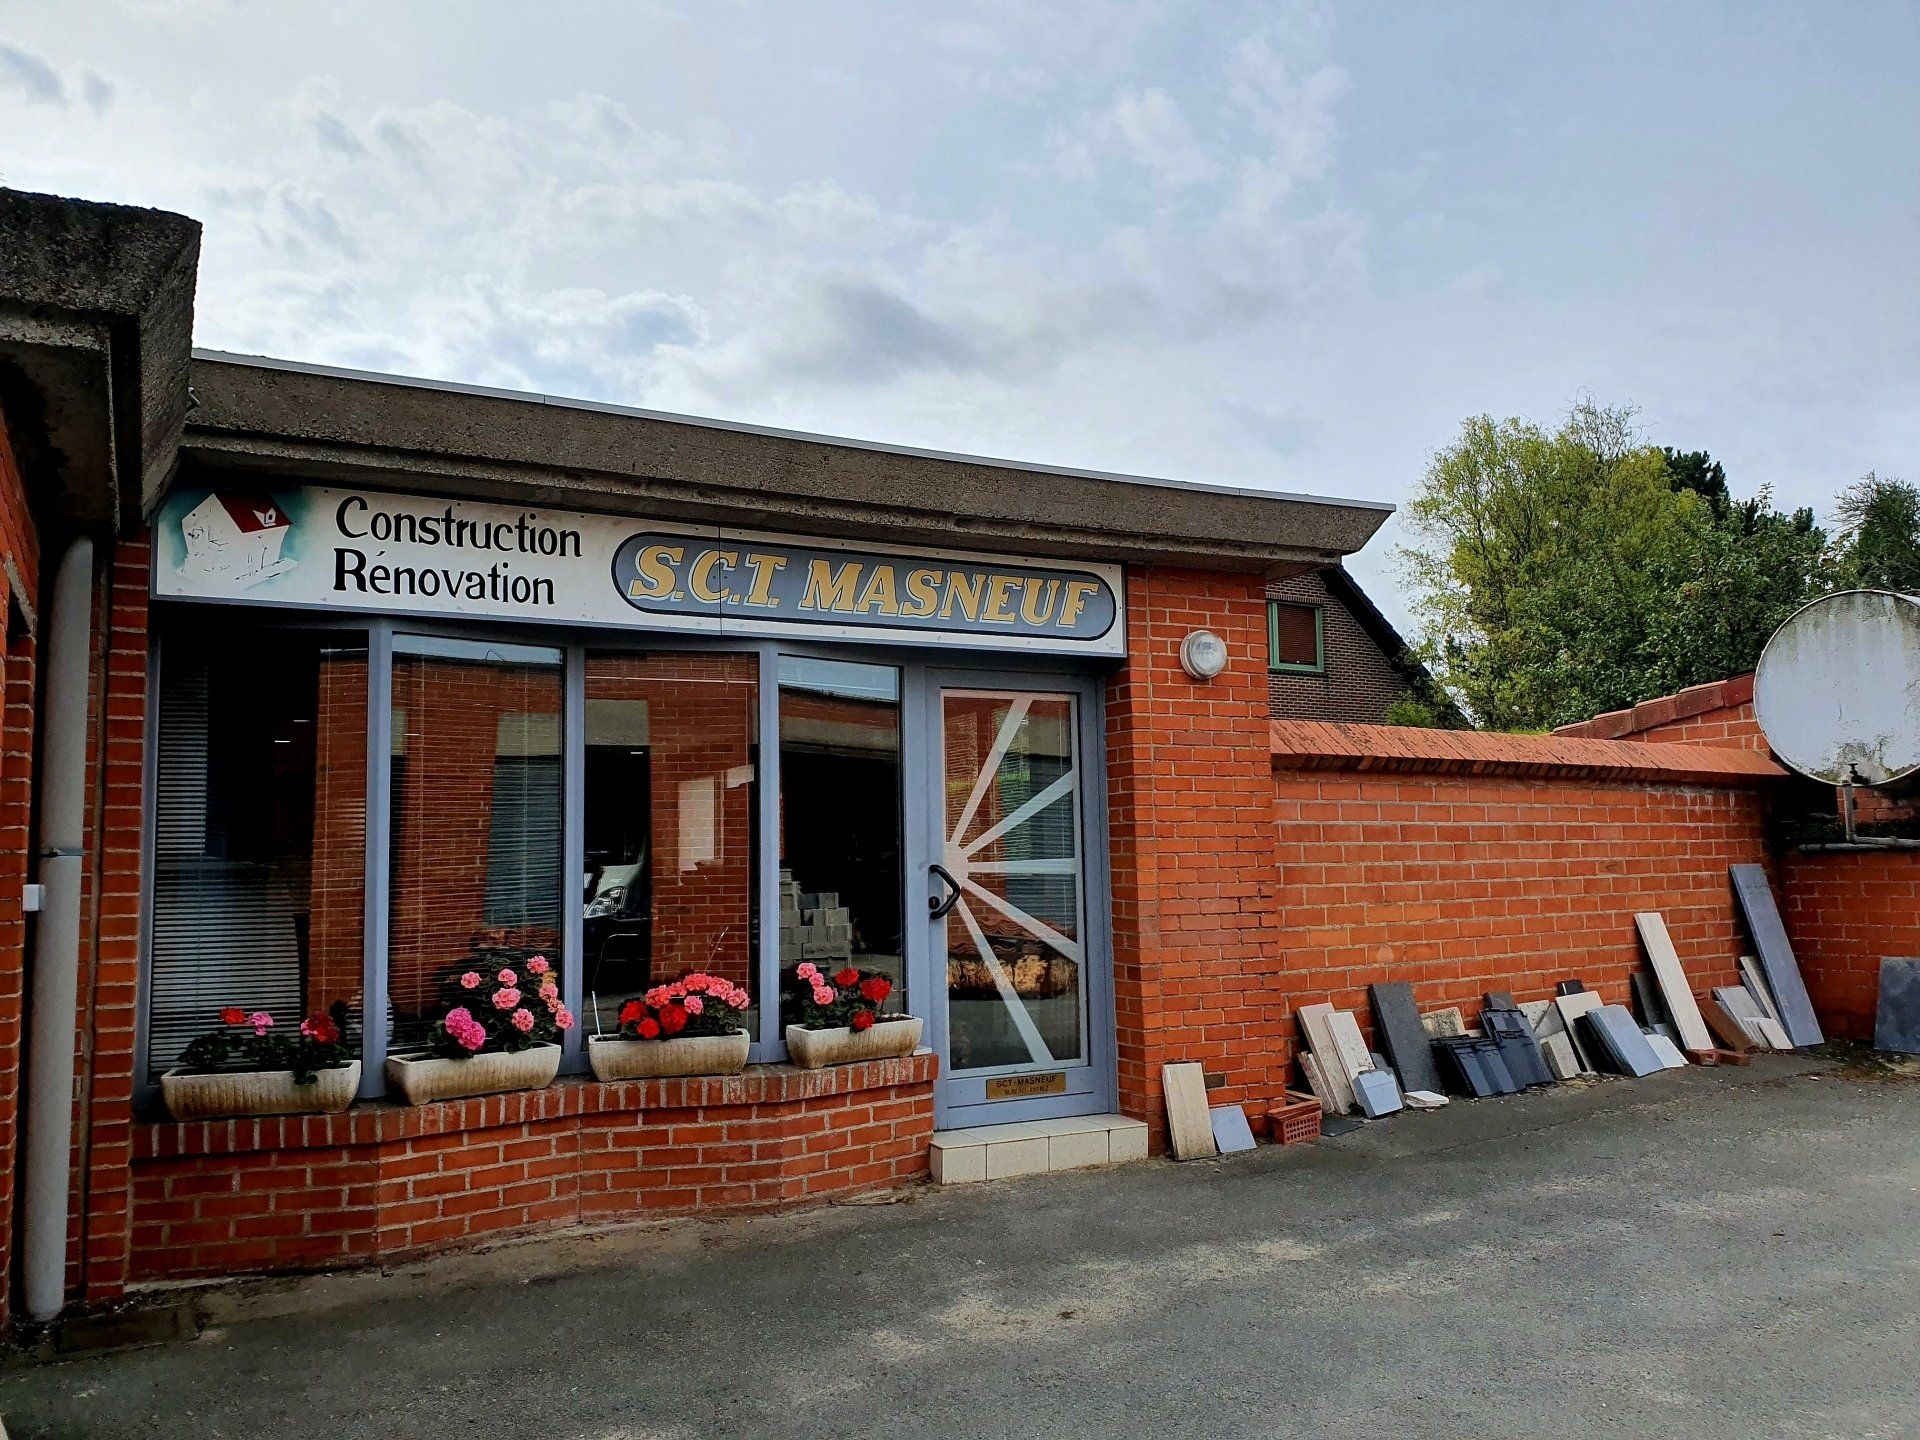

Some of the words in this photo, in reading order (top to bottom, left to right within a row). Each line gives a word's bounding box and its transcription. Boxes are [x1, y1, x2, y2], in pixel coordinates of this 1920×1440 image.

[336, 496, 582, 557] Construction
[333, 548, 555, 604] Rénovation
[800, 558, 1099, 628] MASNEUF
[996, 1075, 1057, 1088] SCT-MASNEUF
